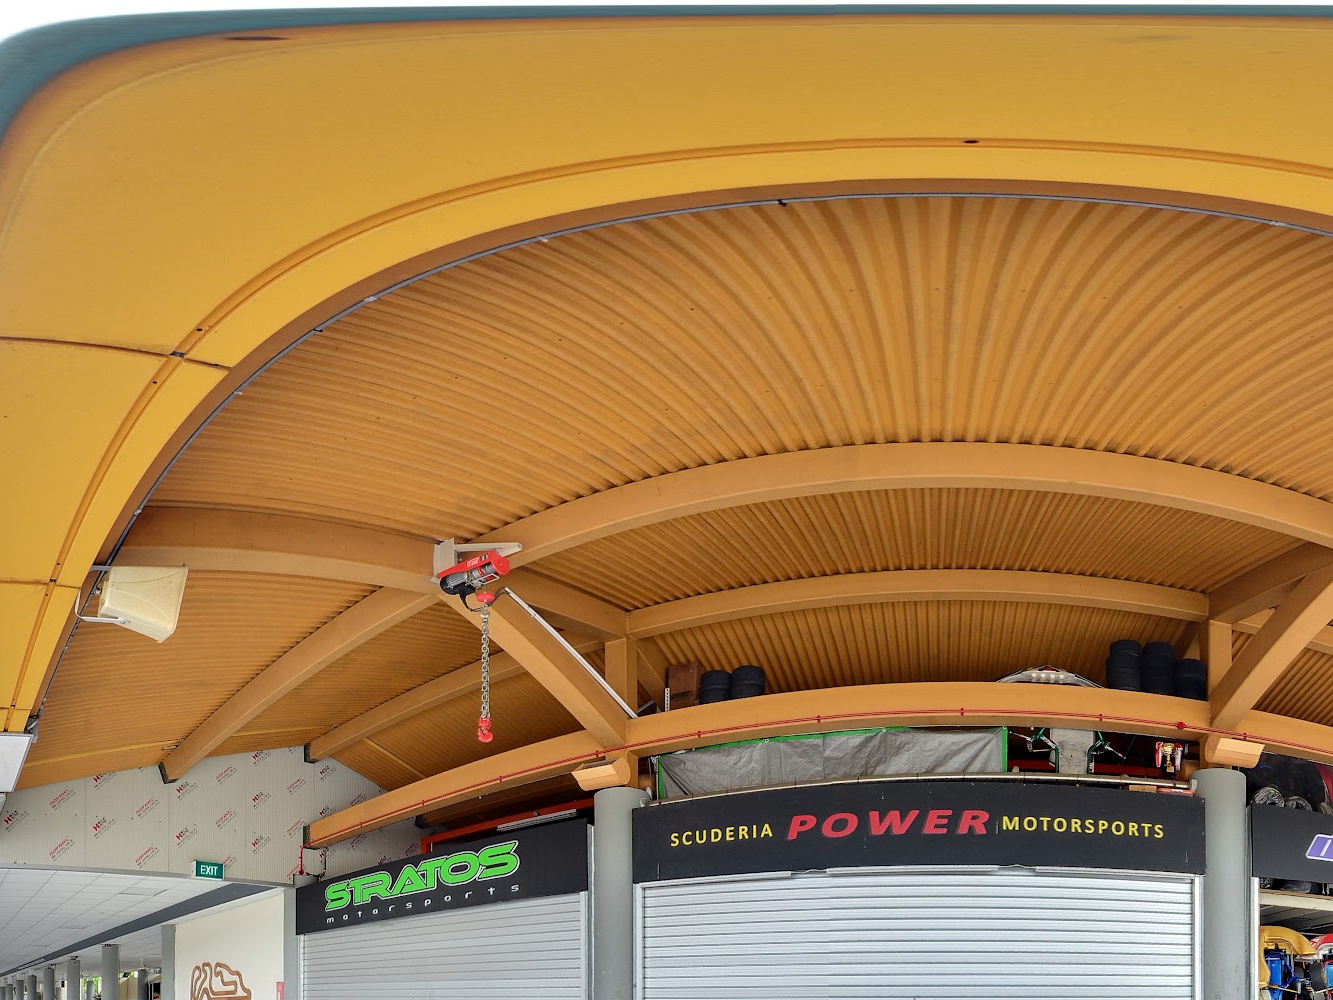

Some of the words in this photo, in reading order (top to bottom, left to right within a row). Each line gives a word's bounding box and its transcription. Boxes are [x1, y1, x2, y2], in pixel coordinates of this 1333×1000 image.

[670, 823, 773, 847] SCUDERIA
[786, 809, 990, 841] POWER
[1002, 815, 1165, 839] MOTORSPORTS
[200, 864, 218, 875] EXIT
[324, 840, 520, 911] STRATOS
[326, 884, 520, 924] motorsports
